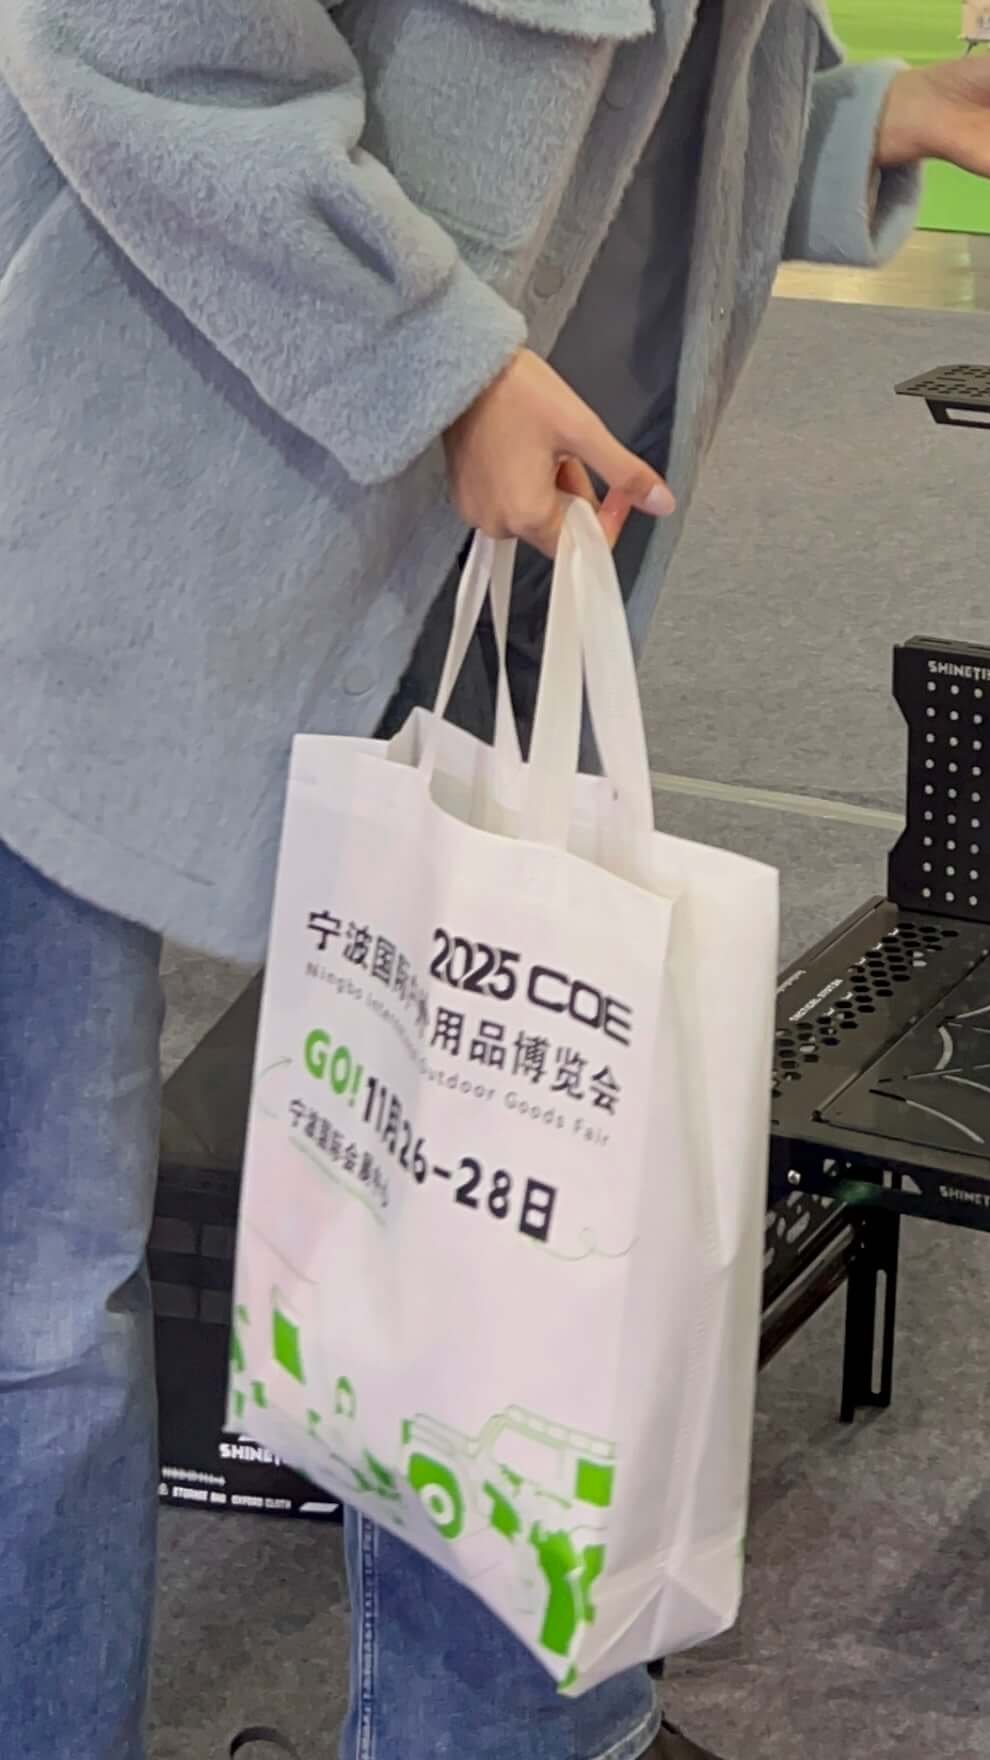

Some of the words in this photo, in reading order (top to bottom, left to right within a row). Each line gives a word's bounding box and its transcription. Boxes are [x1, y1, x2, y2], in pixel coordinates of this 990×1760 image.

[430, 927, 521, 1001] 2025
[303, 1027, 364, 1108] GO!
[362, 1075, 558, 1244] 11月26-28日
[503, 1090, 566, 1130] Goods
[572, 1116, 610, 1147] Fair
